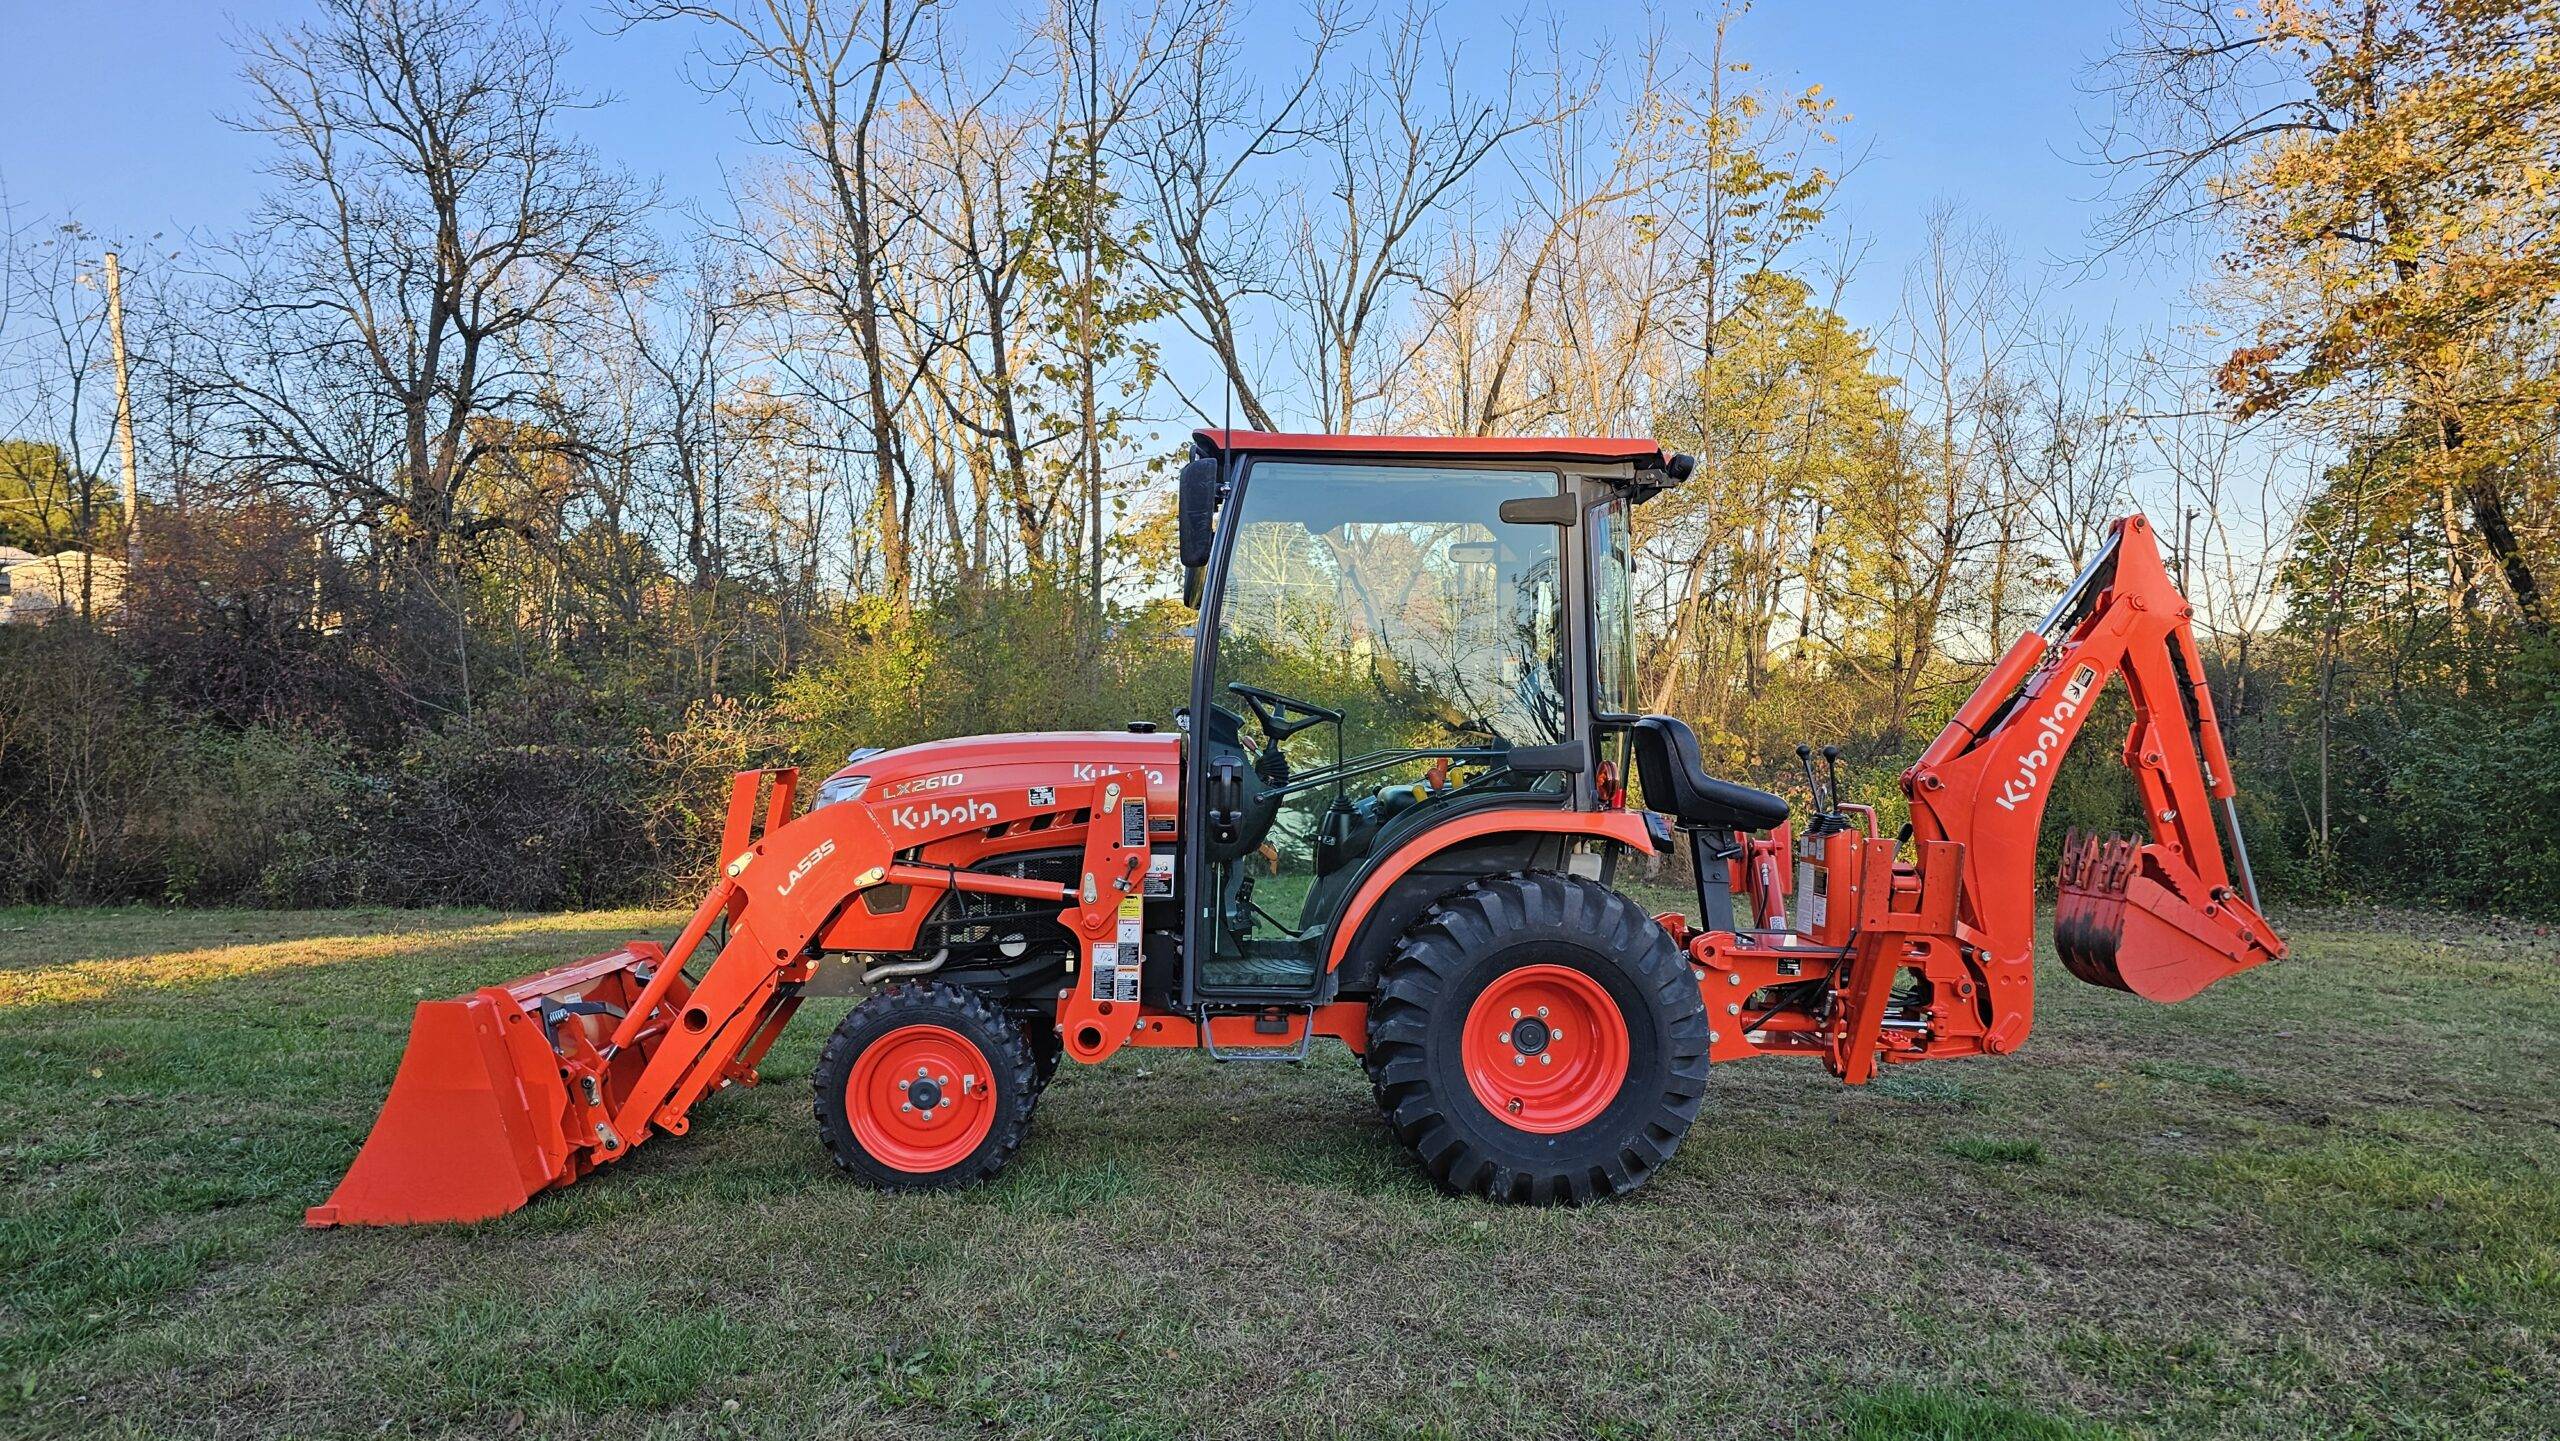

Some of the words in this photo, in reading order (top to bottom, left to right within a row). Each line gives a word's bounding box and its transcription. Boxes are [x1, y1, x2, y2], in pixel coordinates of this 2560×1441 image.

[1996, 701, 2076, 811] Kubota
[883, 773, 964, 799] LX2610
[892, 798, 997, 830] Kubota
[777, 838, 836, 896] LA535
